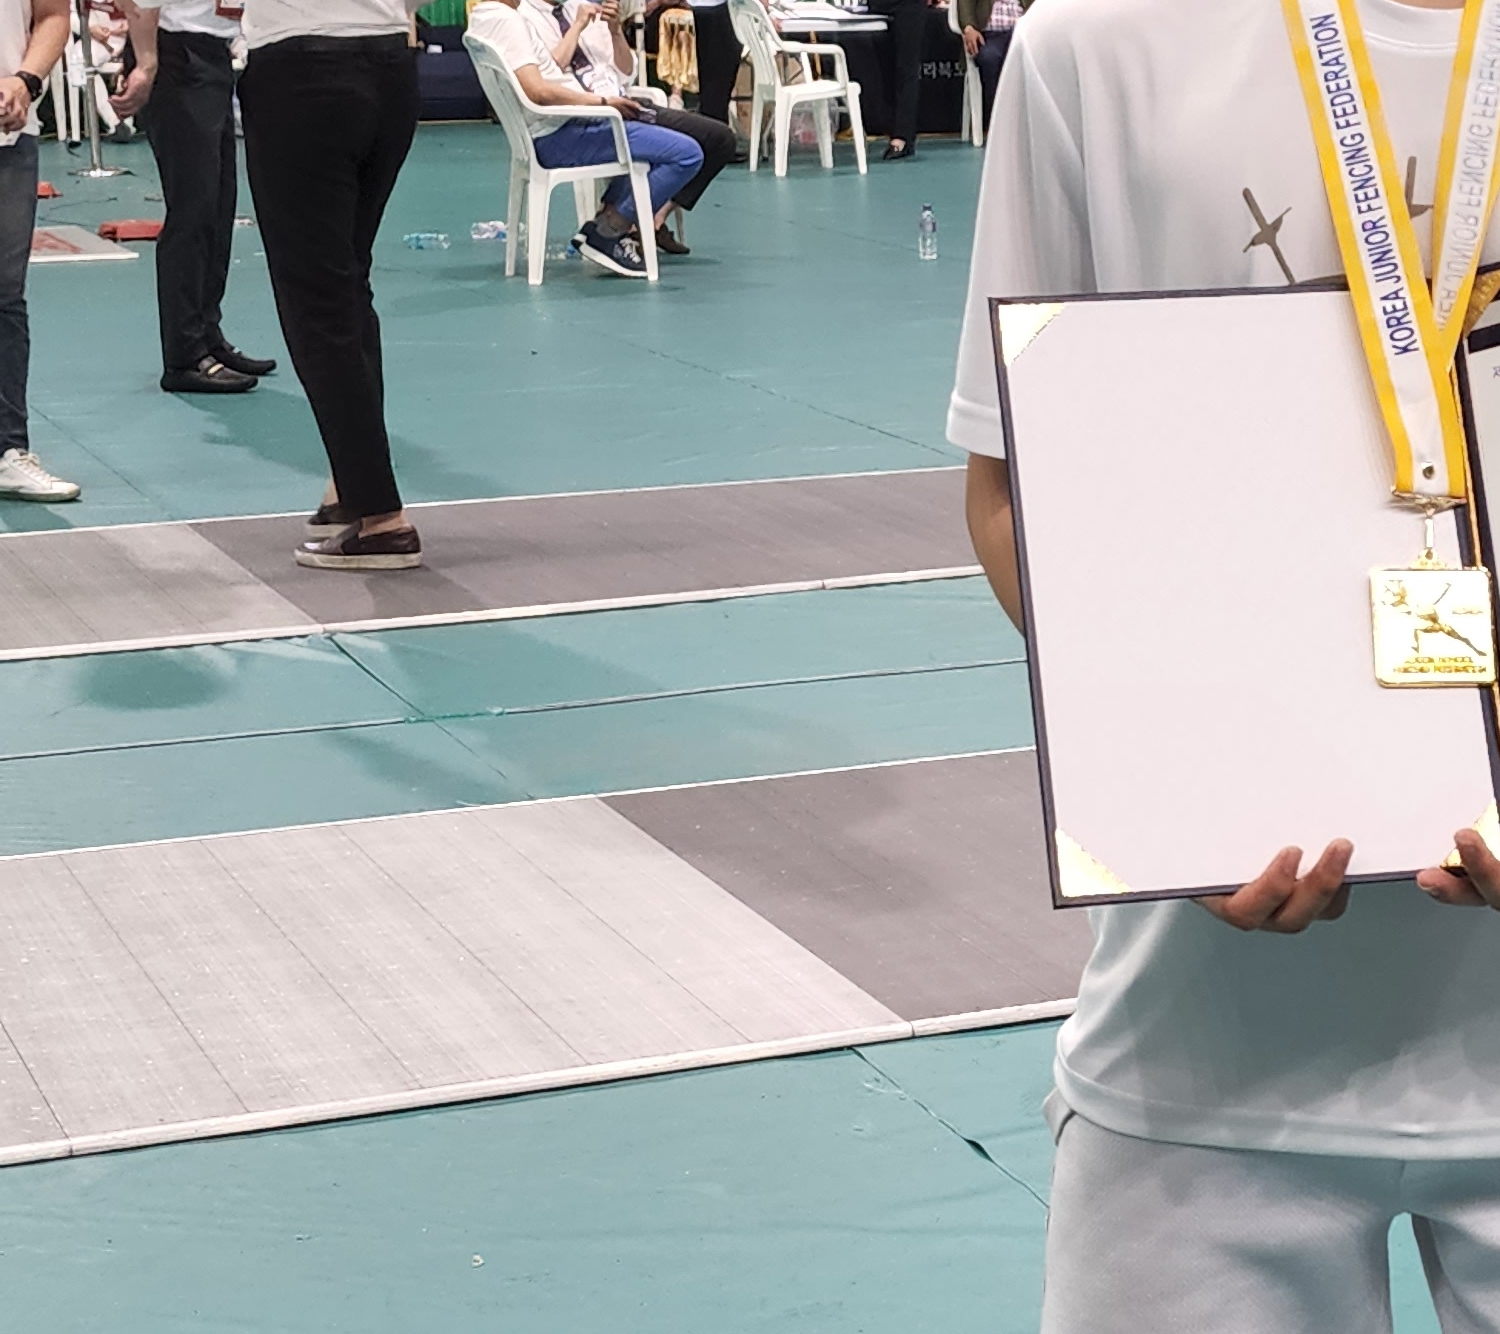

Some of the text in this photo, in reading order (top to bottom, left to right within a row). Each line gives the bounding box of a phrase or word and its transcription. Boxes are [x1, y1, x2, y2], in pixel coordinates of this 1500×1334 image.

[1310, 13, 1420, 356] KOREA JUNIOR FENCING FEDERATION
